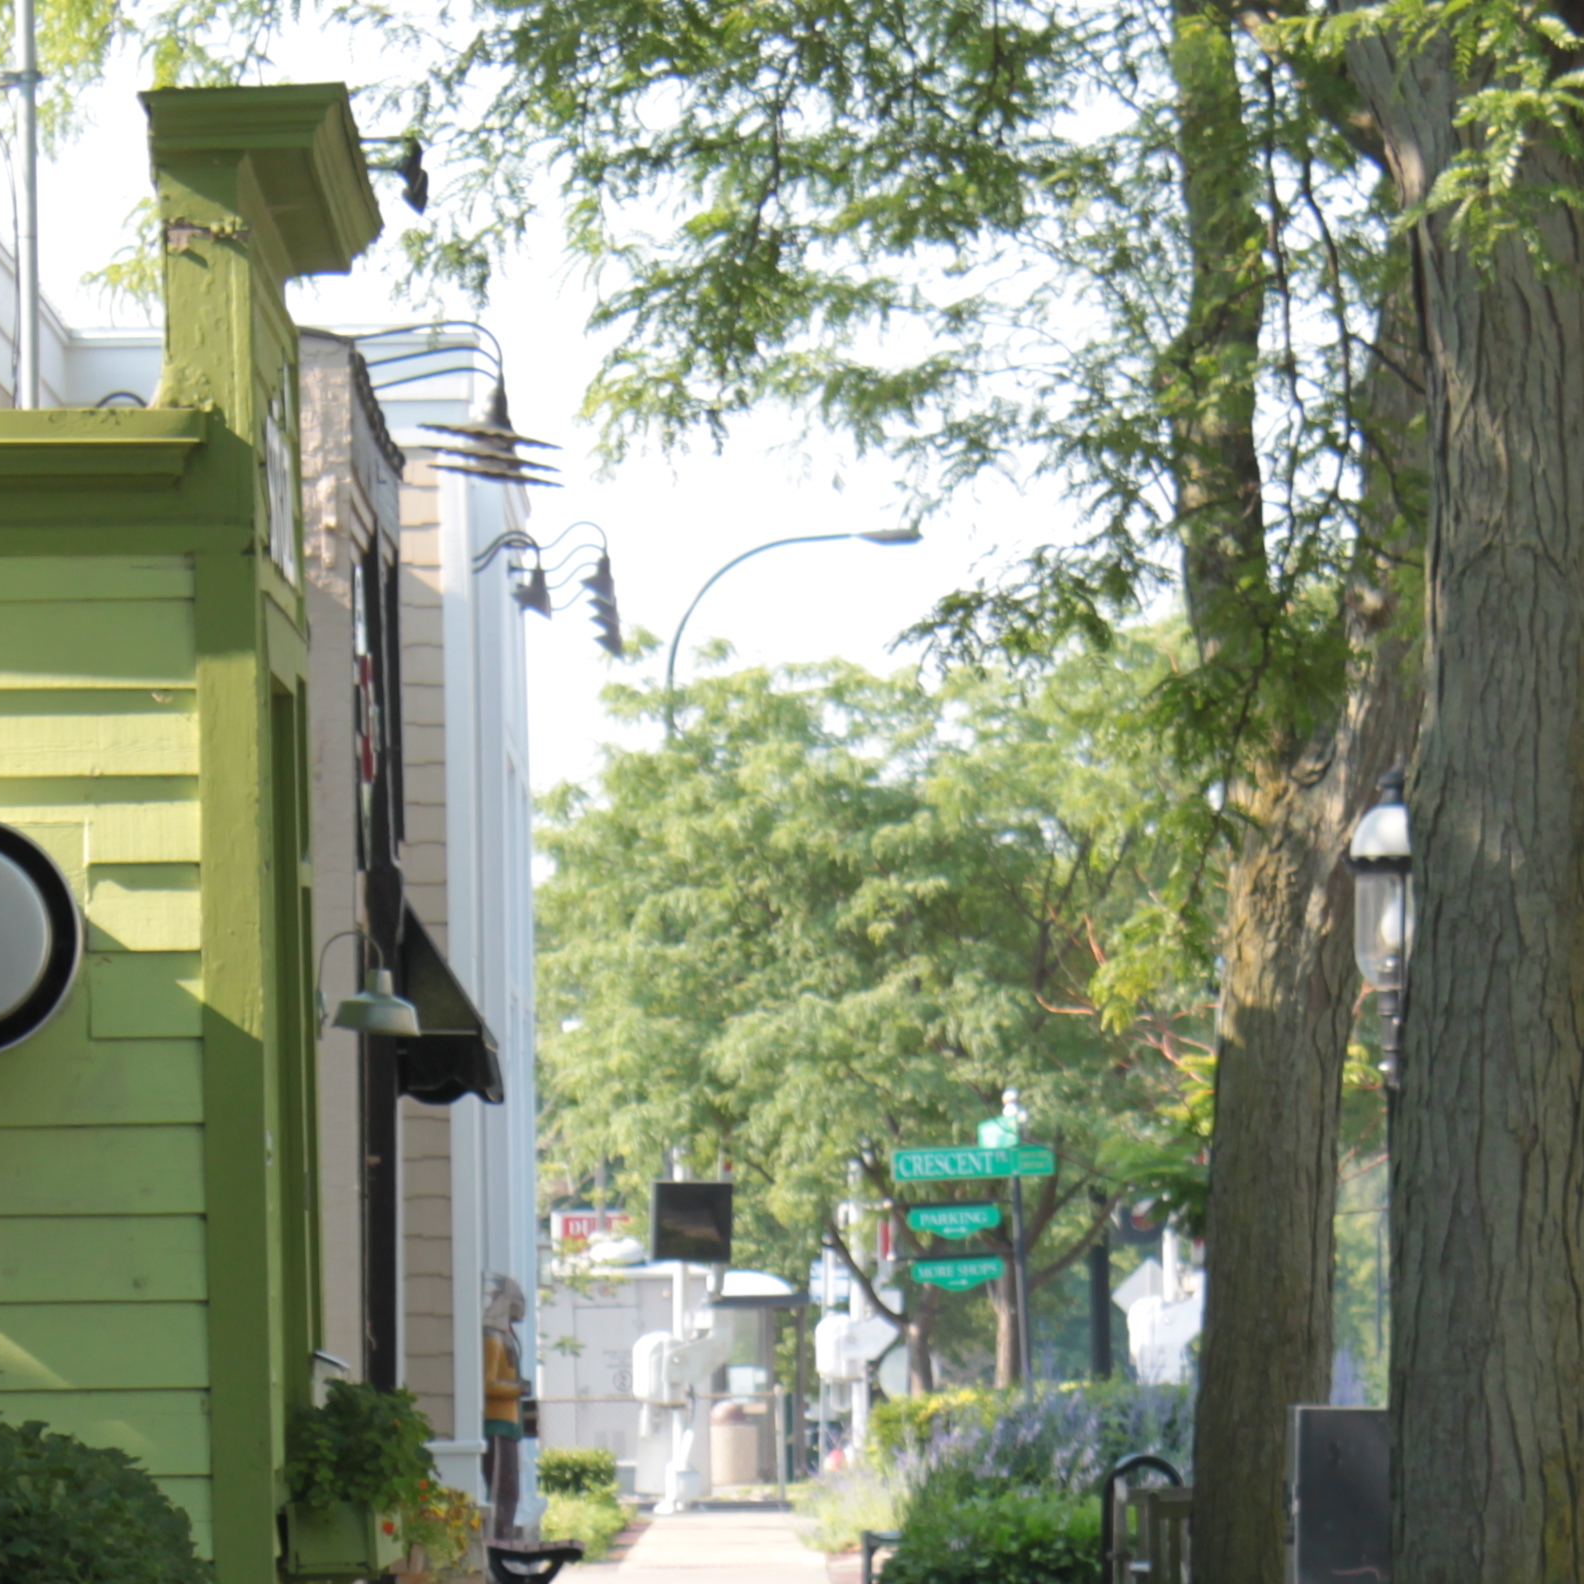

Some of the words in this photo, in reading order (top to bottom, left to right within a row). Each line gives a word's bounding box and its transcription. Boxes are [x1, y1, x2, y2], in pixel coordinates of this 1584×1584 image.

[898, 1151, 994, 1177] CRESCENT
[919, 1211, 988, 1226] PARKING
[917, 1263, 954, 1278] MORE
[957, 1261, 998, 1276] SHOPS
